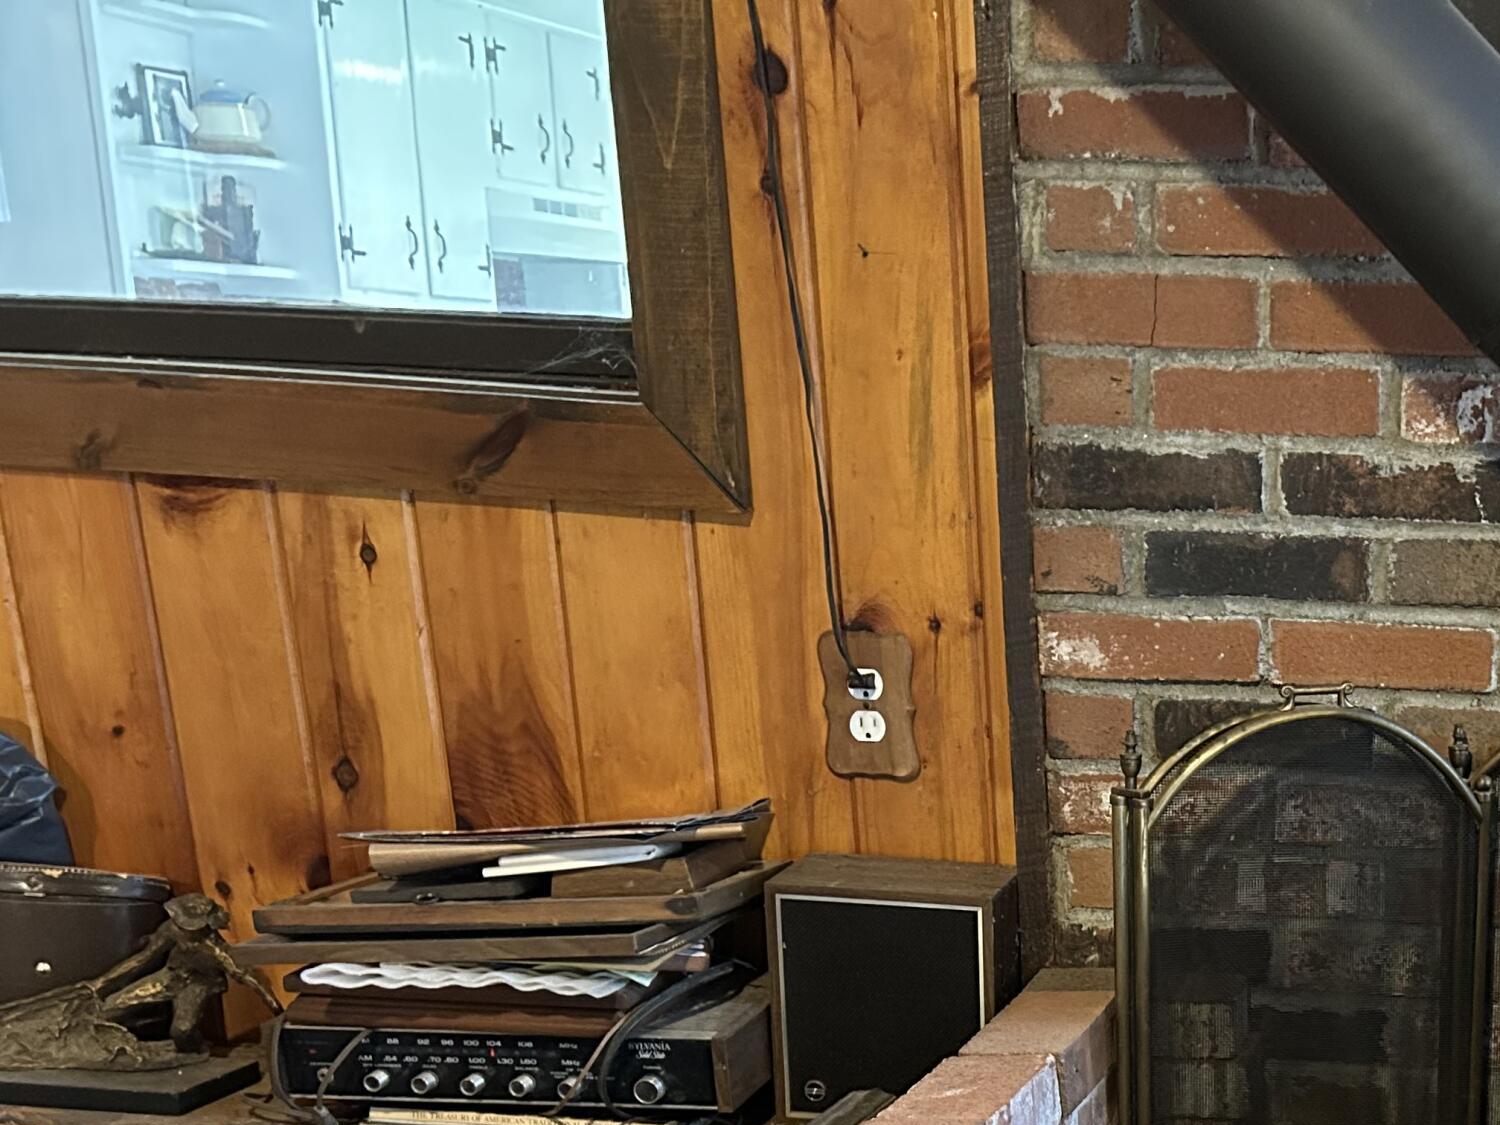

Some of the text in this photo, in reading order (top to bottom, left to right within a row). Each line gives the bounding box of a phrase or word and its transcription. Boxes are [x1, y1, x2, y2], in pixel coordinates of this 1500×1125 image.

[440, 1038, 454, 1046] 96
[628, 1042, 671, 1051] SYLVANIA
[471, 1114, 481, 1122] OF
